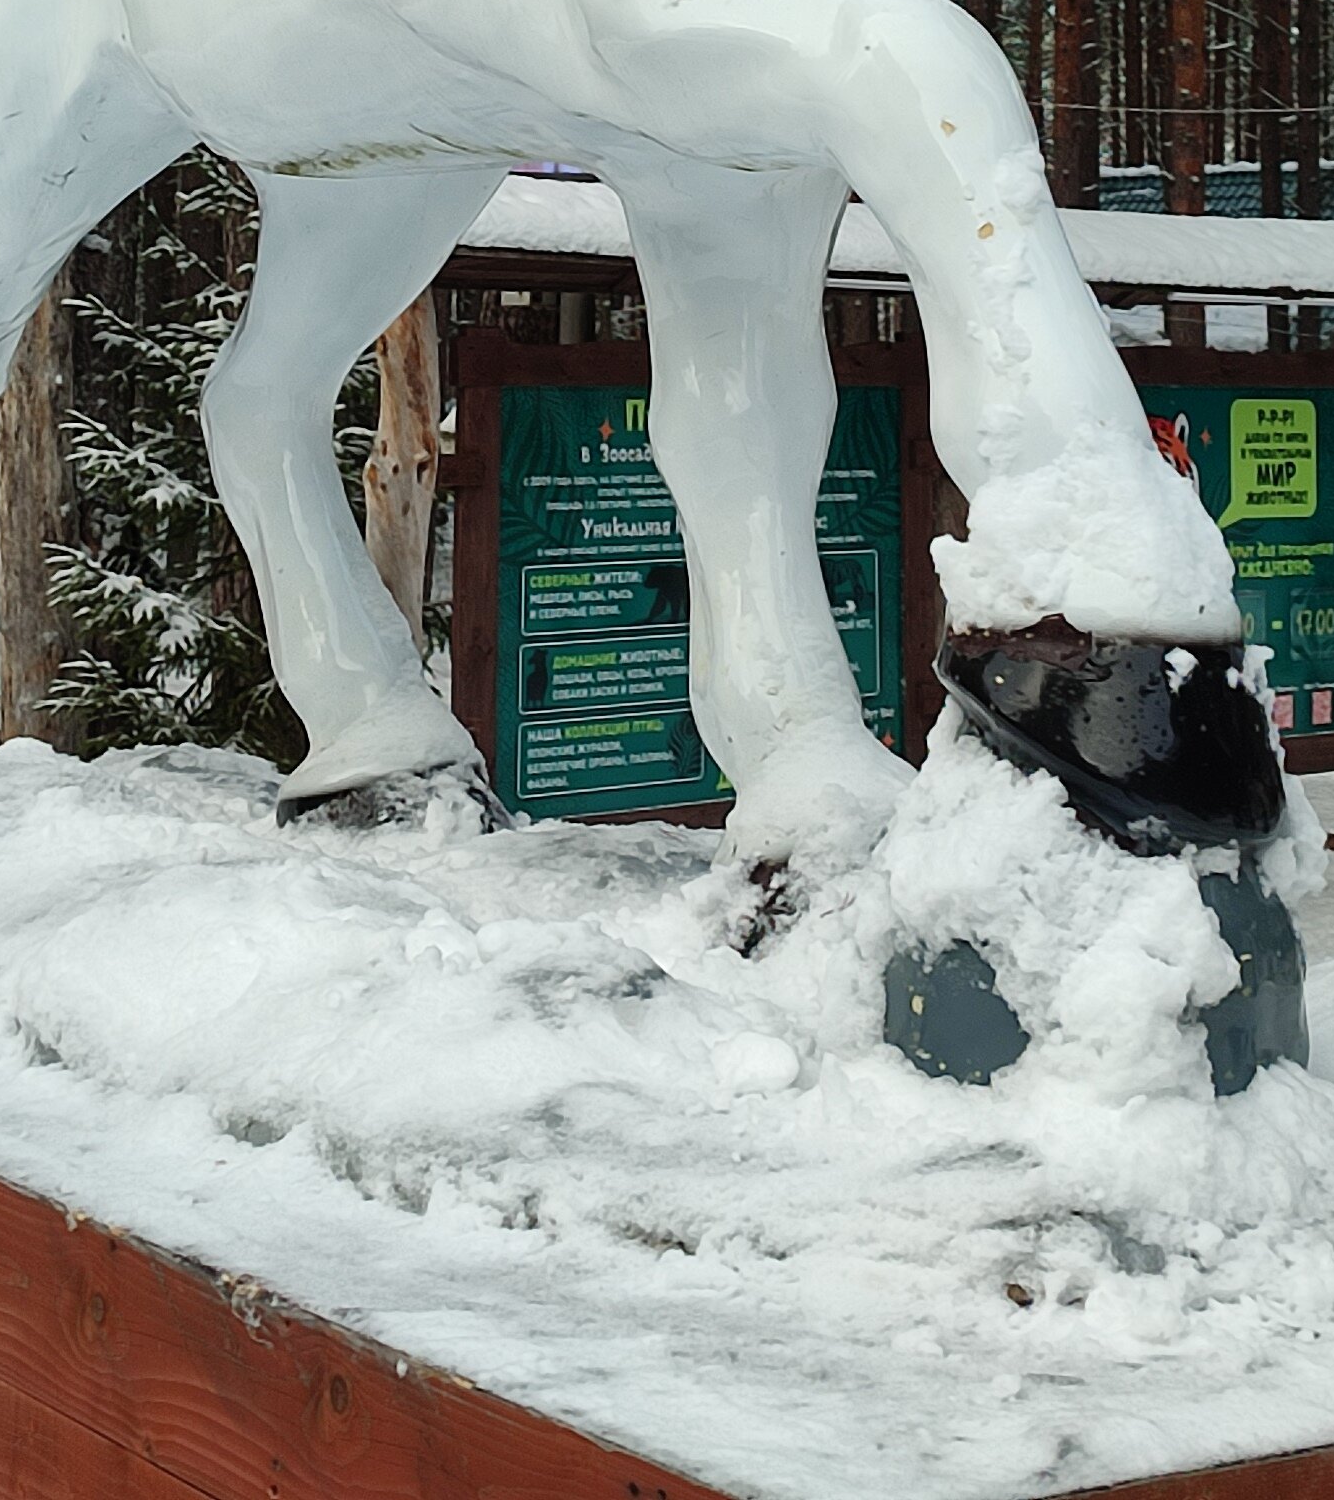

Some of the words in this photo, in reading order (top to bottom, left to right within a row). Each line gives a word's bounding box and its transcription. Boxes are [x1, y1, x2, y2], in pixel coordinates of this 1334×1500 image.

[1257, 462, 1296, 487] МИР
[581, 516, 671, 539] Уникальная
[527, 728, 562, 743] НАША
